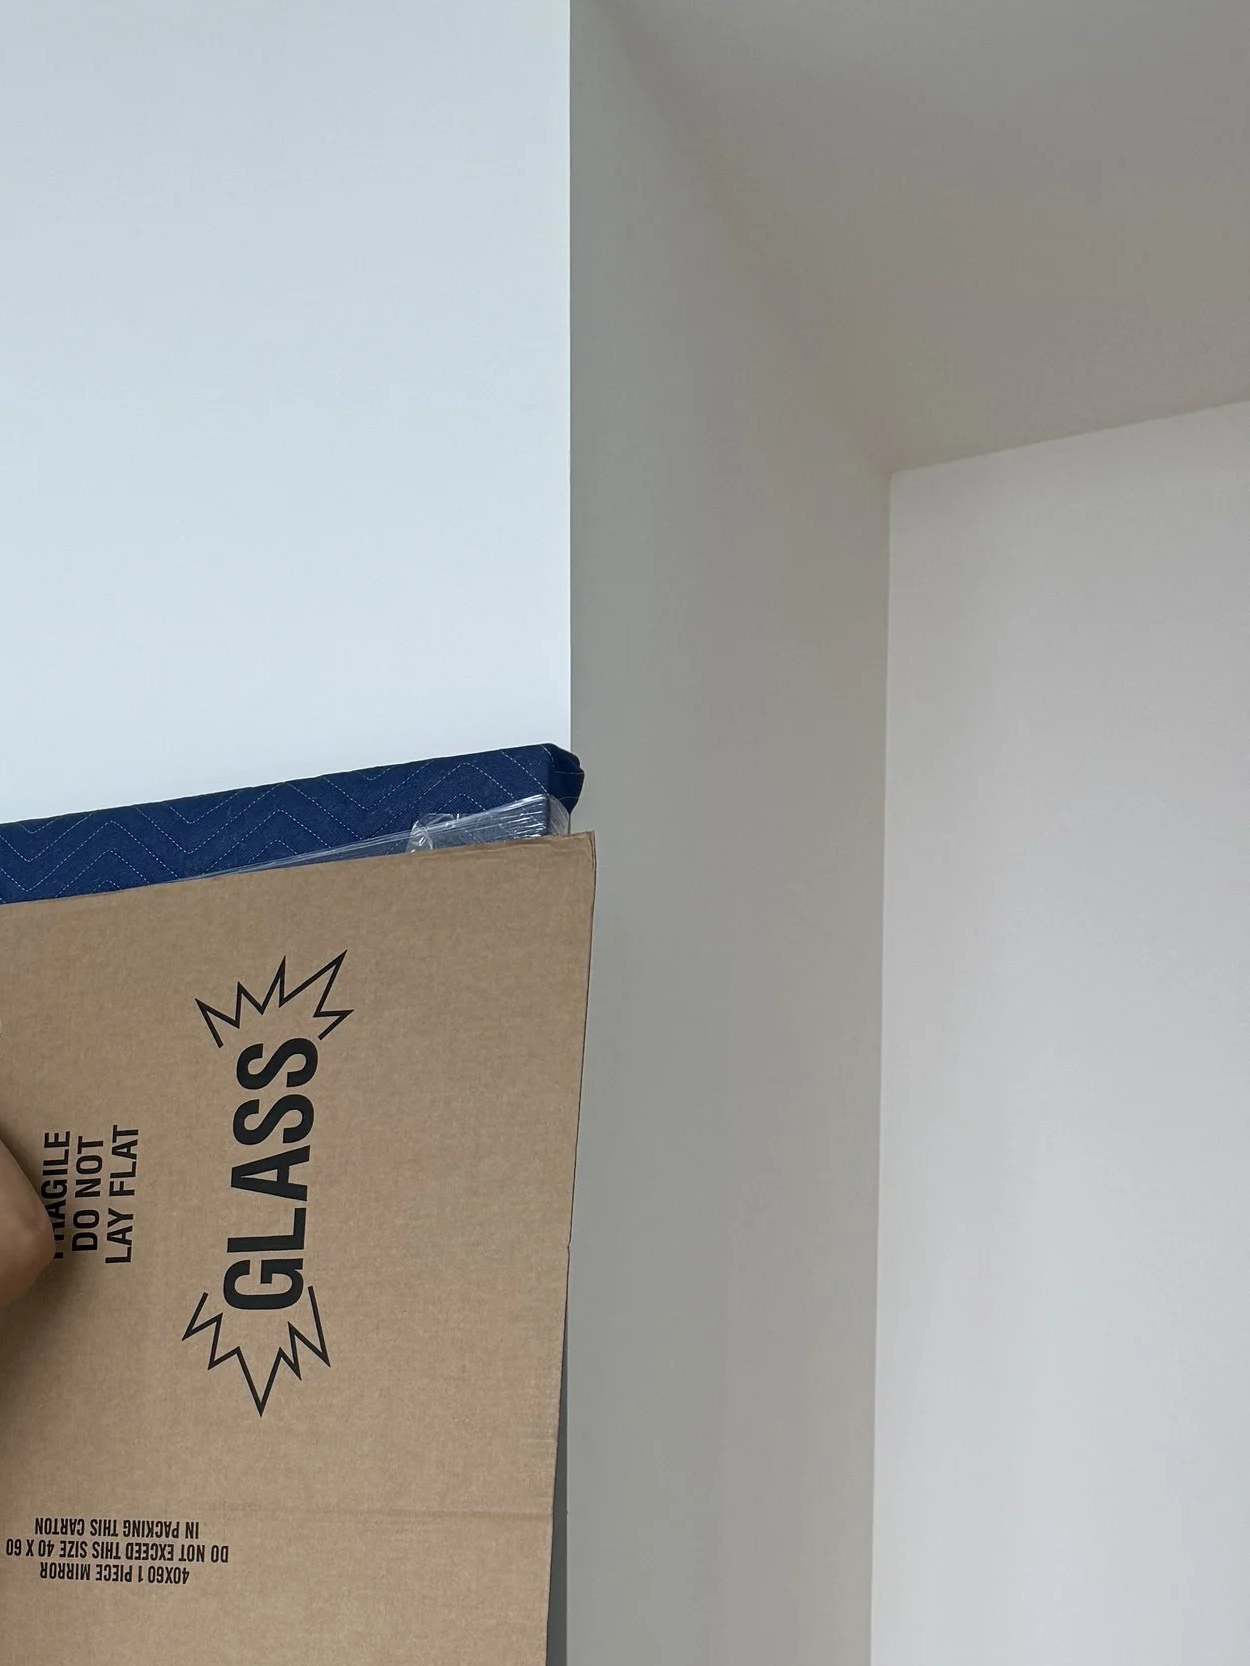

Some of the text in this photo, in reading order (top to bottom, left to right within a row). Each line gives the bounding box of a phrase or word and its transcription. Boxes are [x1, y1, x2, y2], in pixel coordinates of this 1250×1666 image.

[41, 1130, 70, 1259] AGILE
[72, 1135, 104, 1252] DO NOT
[105, 1124, 139, 1263] LAY FLAT
[223, 1036, 319, 1311] GLASS
[6, 1538, 229, 1563] DO NOT EXCEED THIS SIZE 40 X 60
[35, 1517, 199, 1539] IN PACKING THIS CARTON
[40, 1562, 190, 1584] 40X60 1 PIECE MIRROR
